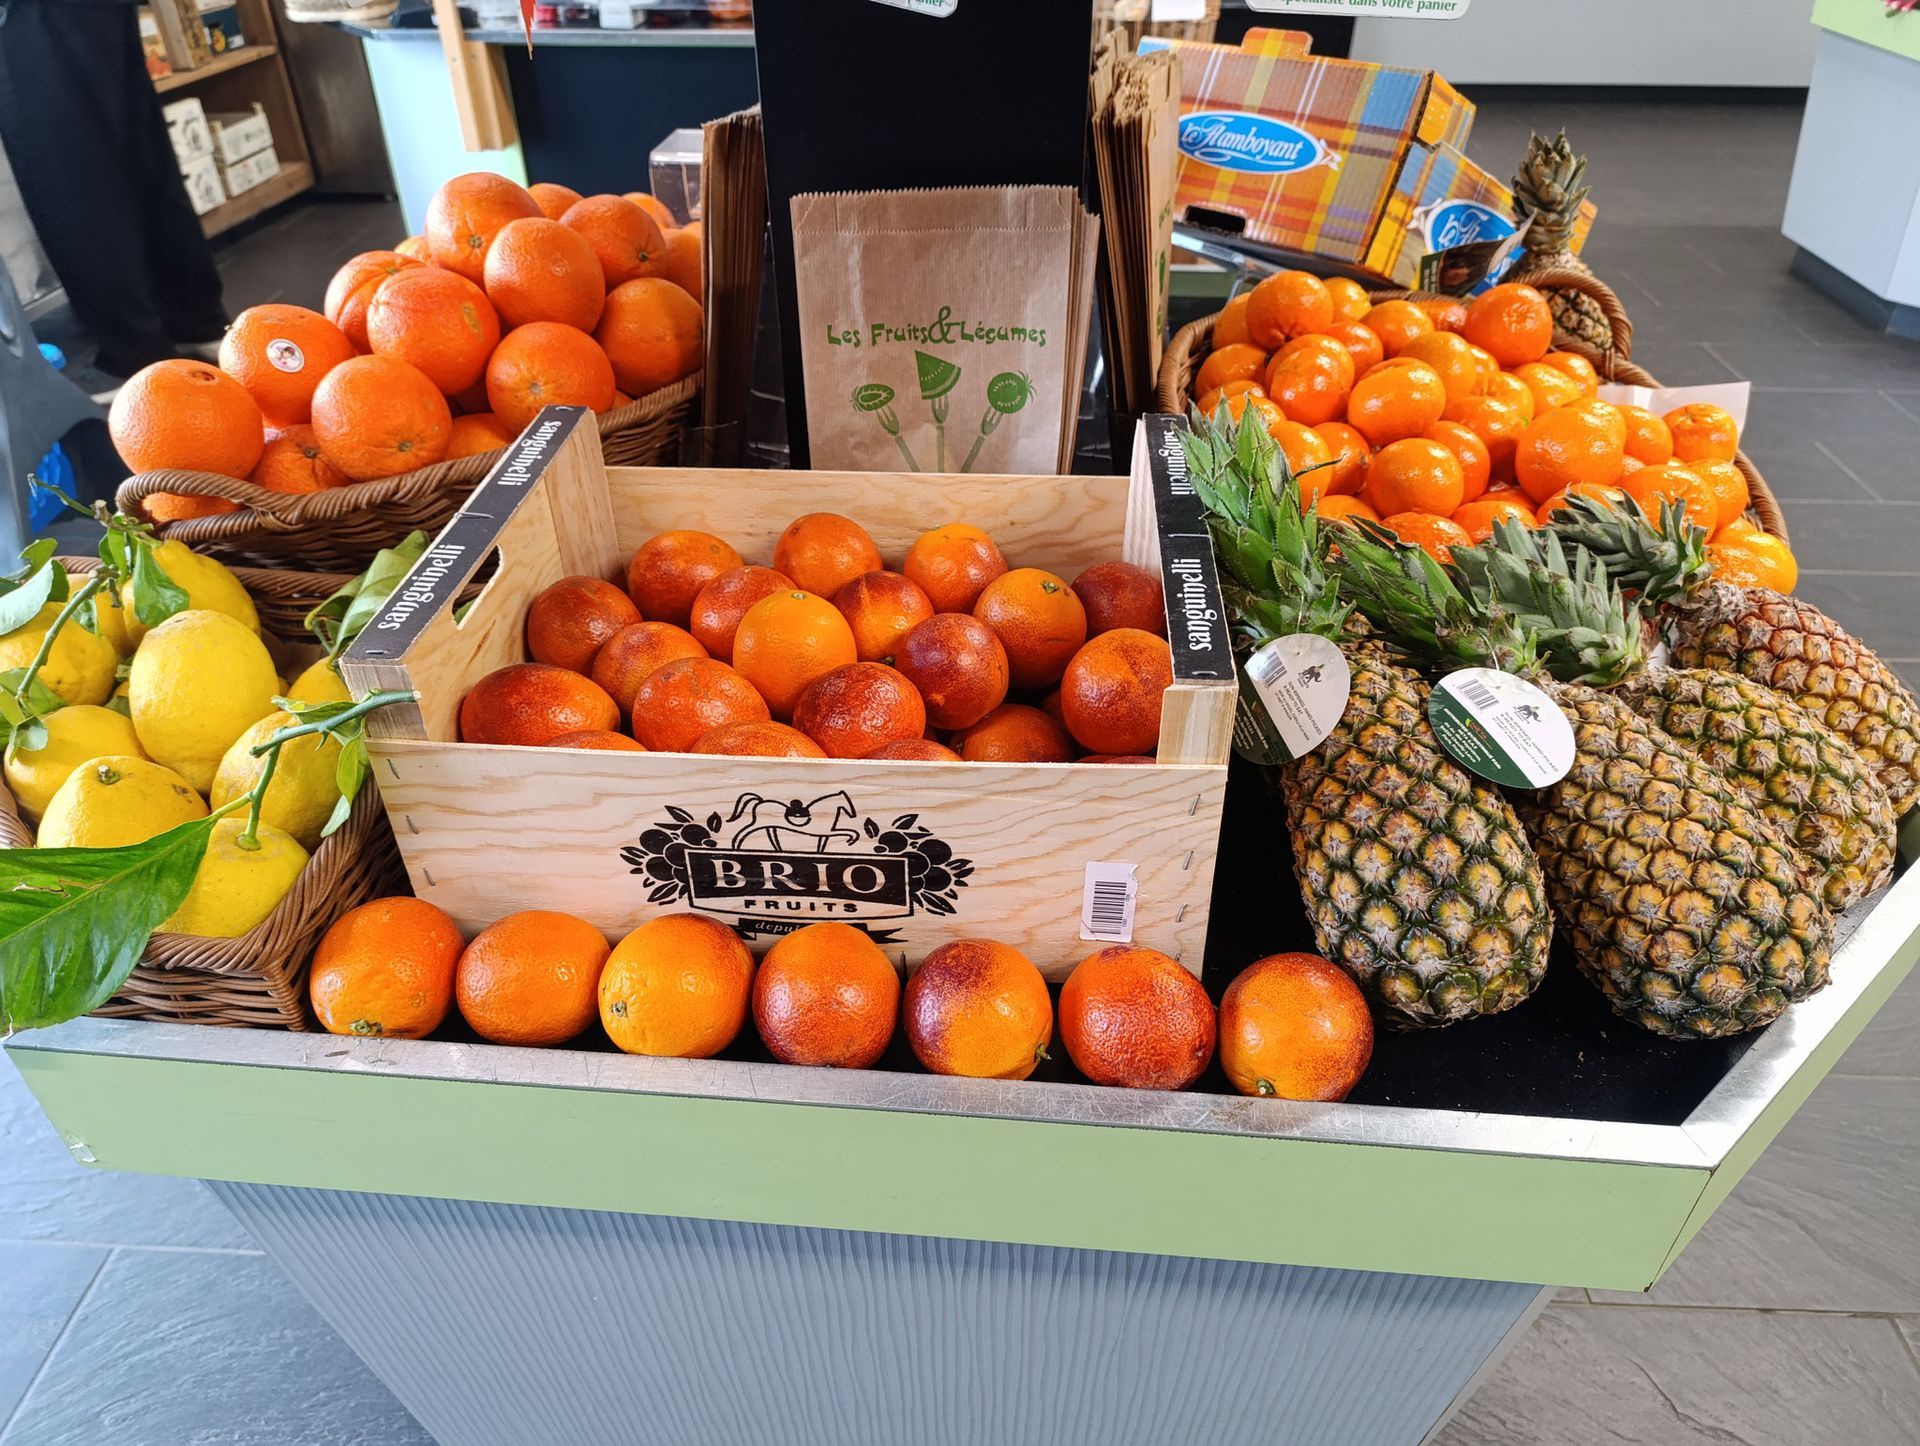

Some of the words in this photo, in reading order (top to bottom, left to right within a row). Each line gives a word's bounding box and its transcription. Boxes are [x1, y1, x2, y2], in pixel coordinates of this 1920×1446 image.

[1382, 0, 1414, 9] votre
[1417, 0, 1457, 13] panier
[1199, 116, 1304, 161] Flamboyant
[827, 323, 861, 347] Les
[871, 322, 930, 346] Fruits
[929, 304, 955, 345] &
[961, 318, 1047, 348] Légumes
[497, 420, 562, 486] sanguinelli
[377, 544, 466, 632] sanguinelli
[1171, 558, 1218, 652] sanguinelli
[709, 859, 886, 895] BRIO
[743, 899, 859, 914] FRUITS
[755, 921, 801, 933] depui
